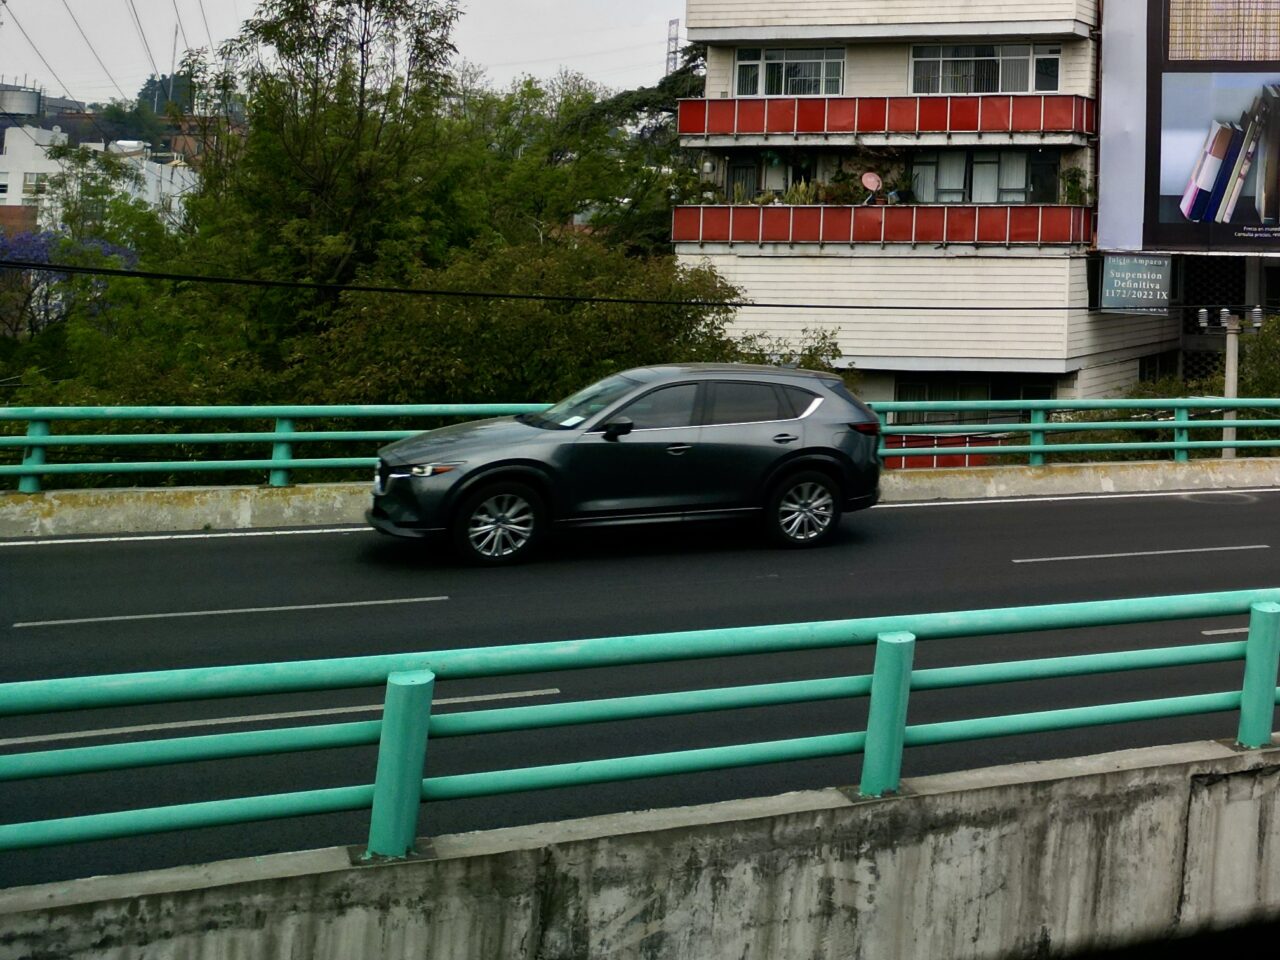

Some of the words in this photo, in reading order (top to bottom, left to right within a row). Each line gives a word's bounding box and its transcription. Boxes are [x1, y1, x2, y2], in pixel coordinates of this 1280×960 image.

[1134, 257, 1162, 266] Amparo
[1114, 279, 1160, 289] Definitiva
[1105, 289, 1153, 299] 1172/2022
